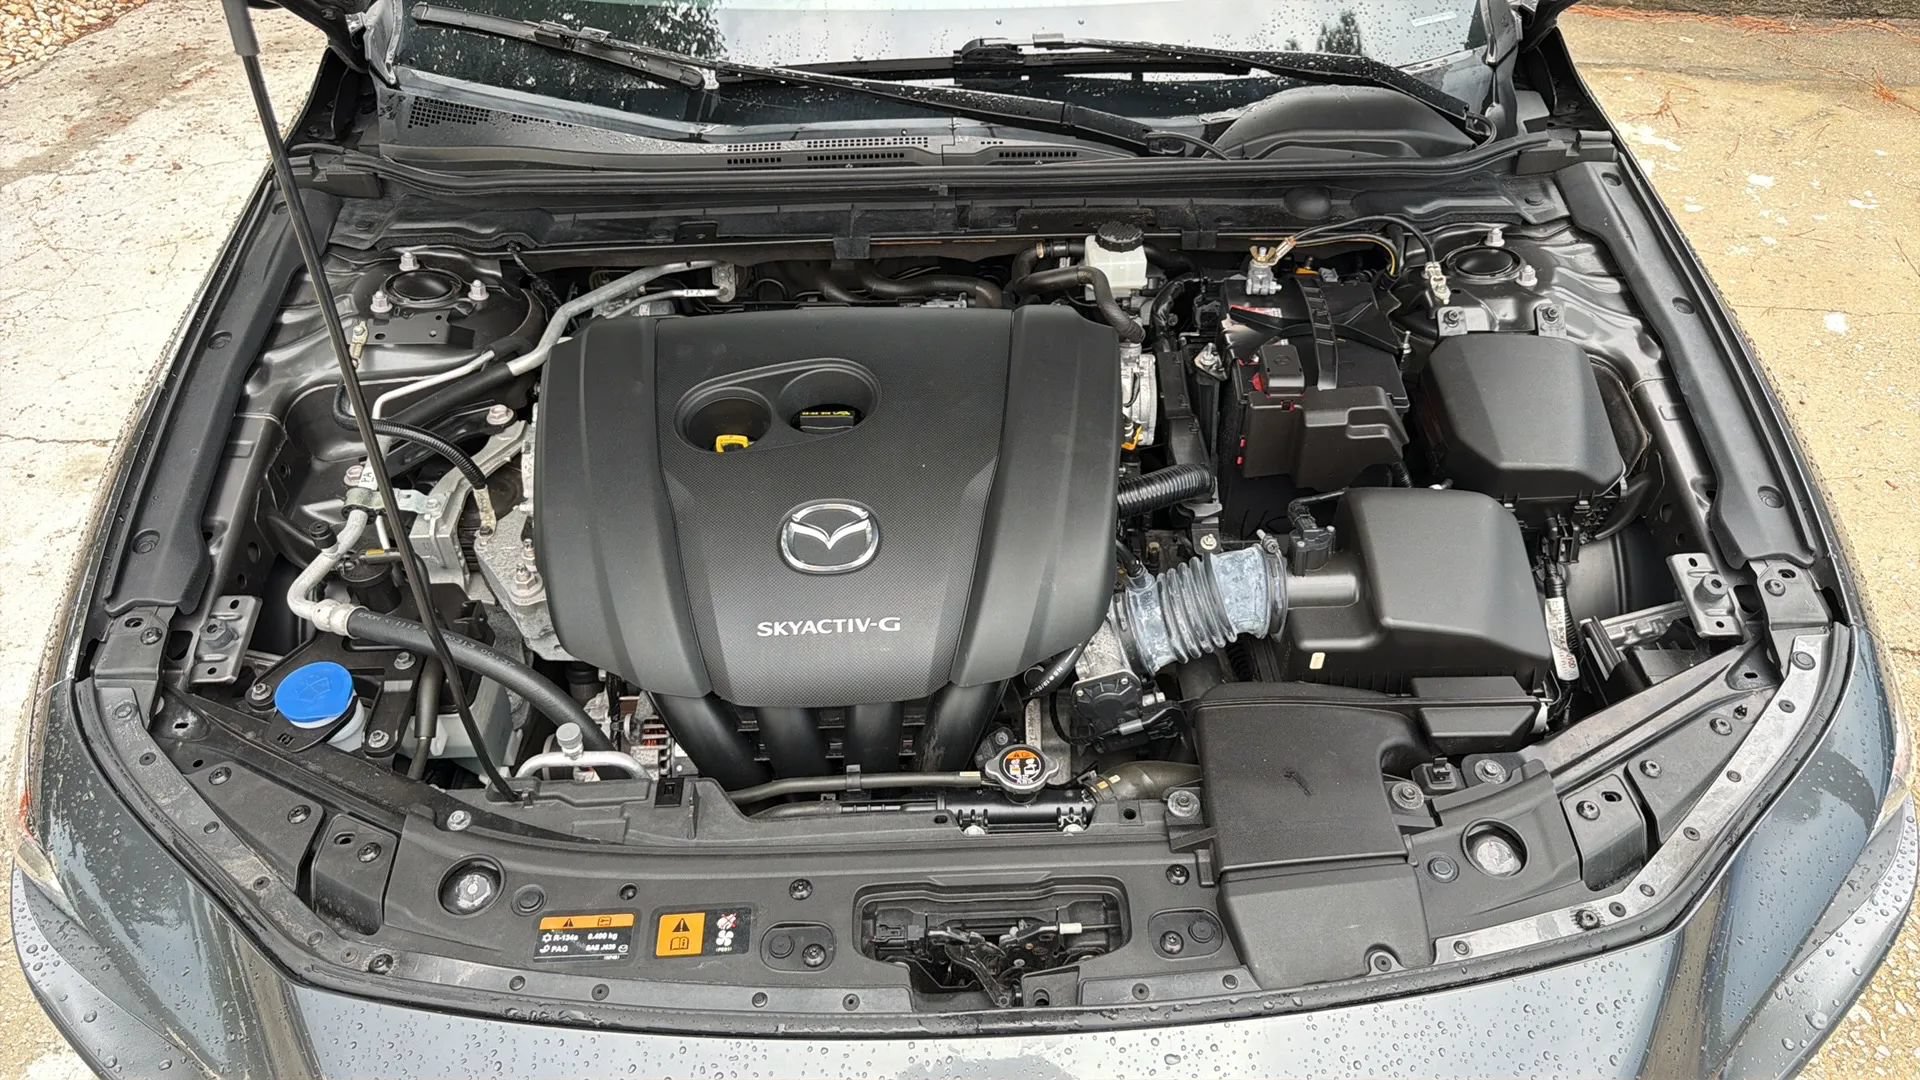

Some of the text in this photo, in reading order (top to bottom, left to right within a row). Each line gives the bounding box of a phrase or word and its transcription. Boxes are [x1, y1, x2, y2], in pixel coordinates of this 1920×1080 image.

[756, 617, 901, 637] SKYACTIV-G
[553, 934, 579, 942] R-134a
[608, 932, 618, 940] kg
[550, 945, 569, 953] PAG
